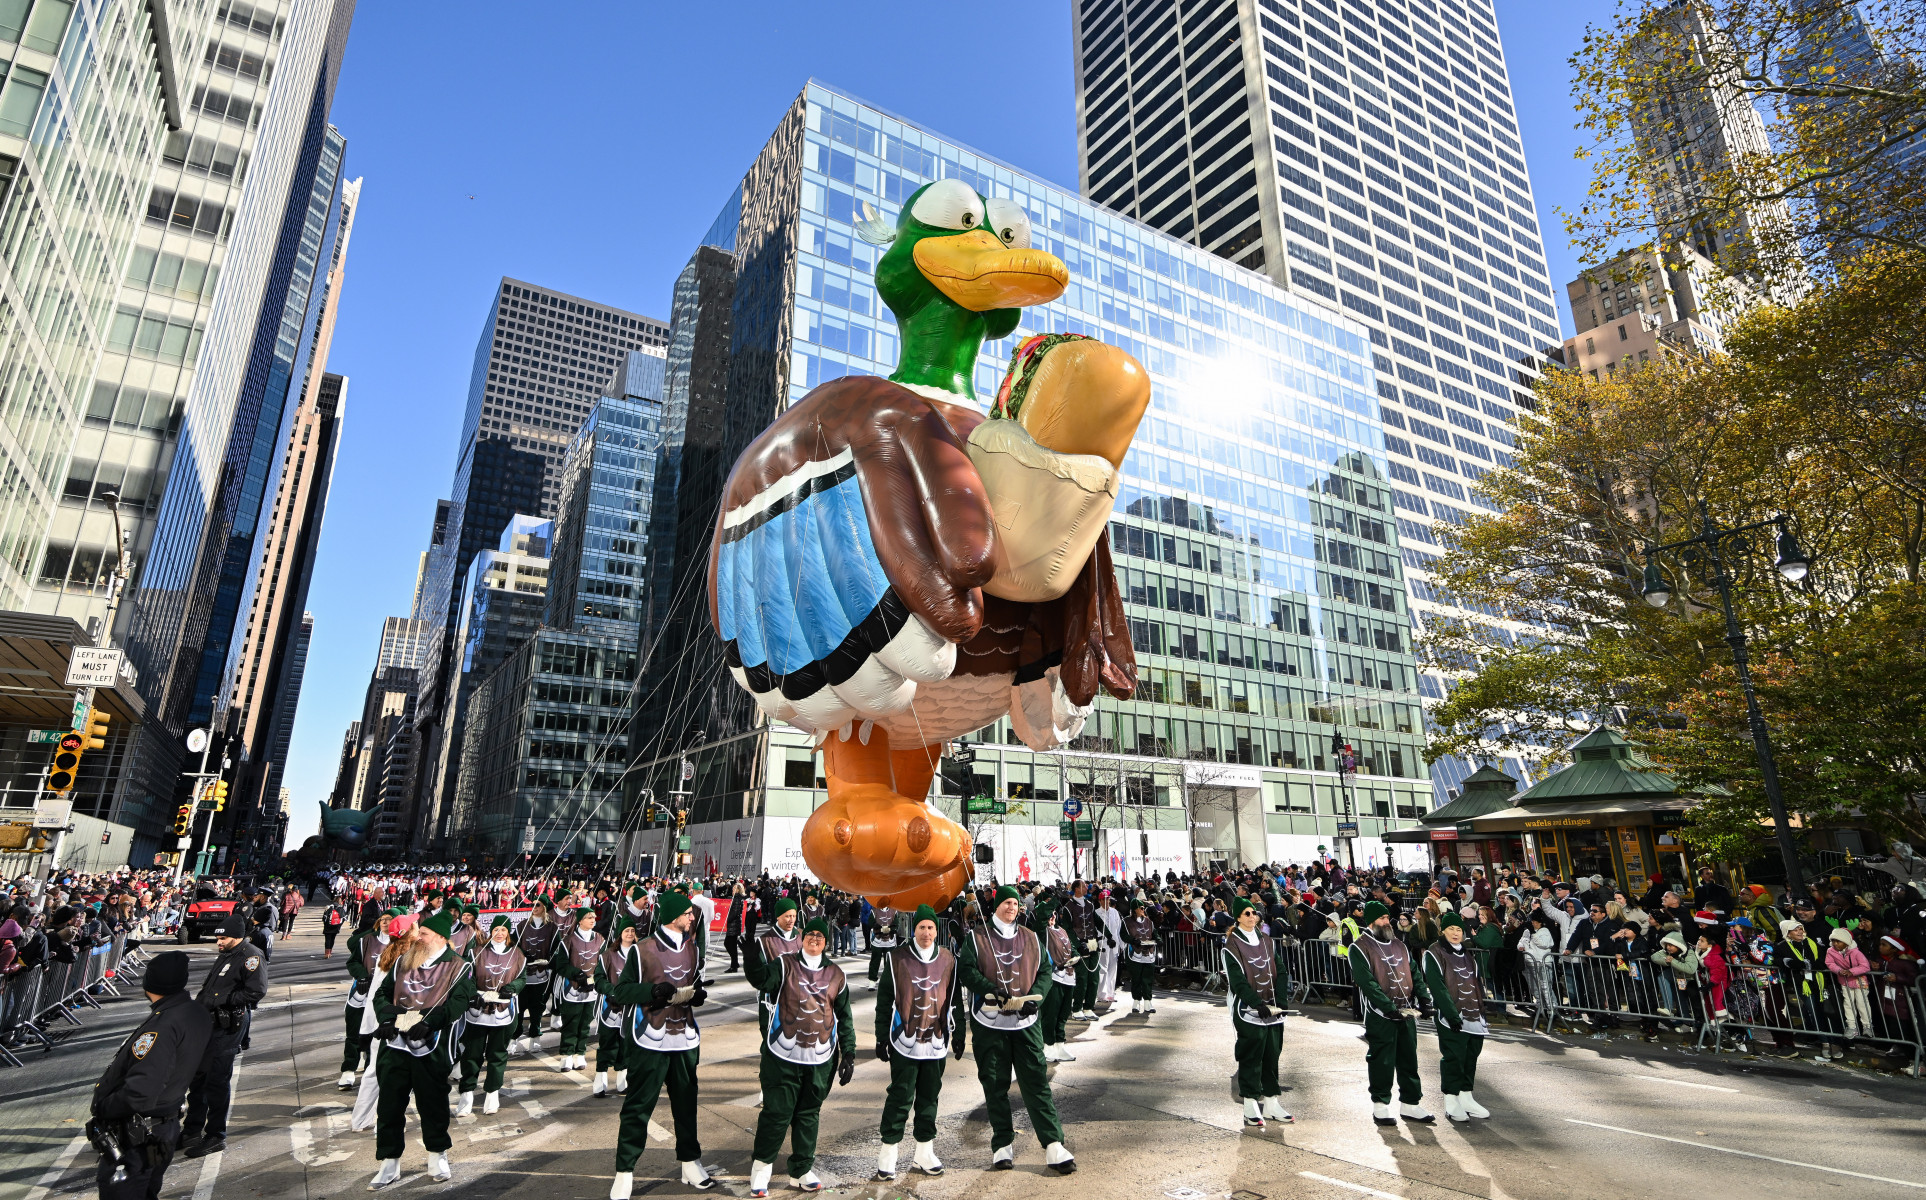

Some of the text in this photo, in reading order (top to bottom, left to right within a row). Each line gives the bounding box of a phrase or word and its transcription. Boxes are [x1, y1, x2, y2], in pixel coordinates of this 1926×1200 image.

[81, 662, 108, 671] MUST
[72, 673, 92, 681] TURN
[39, 732, 61, 742] W 42
[1524, 818, 1552, 828] wafels
[1562, 817, 1591, 828] dinges
[785, 847, 802, 860] Exp
[771, 861, 800, 871] winter
